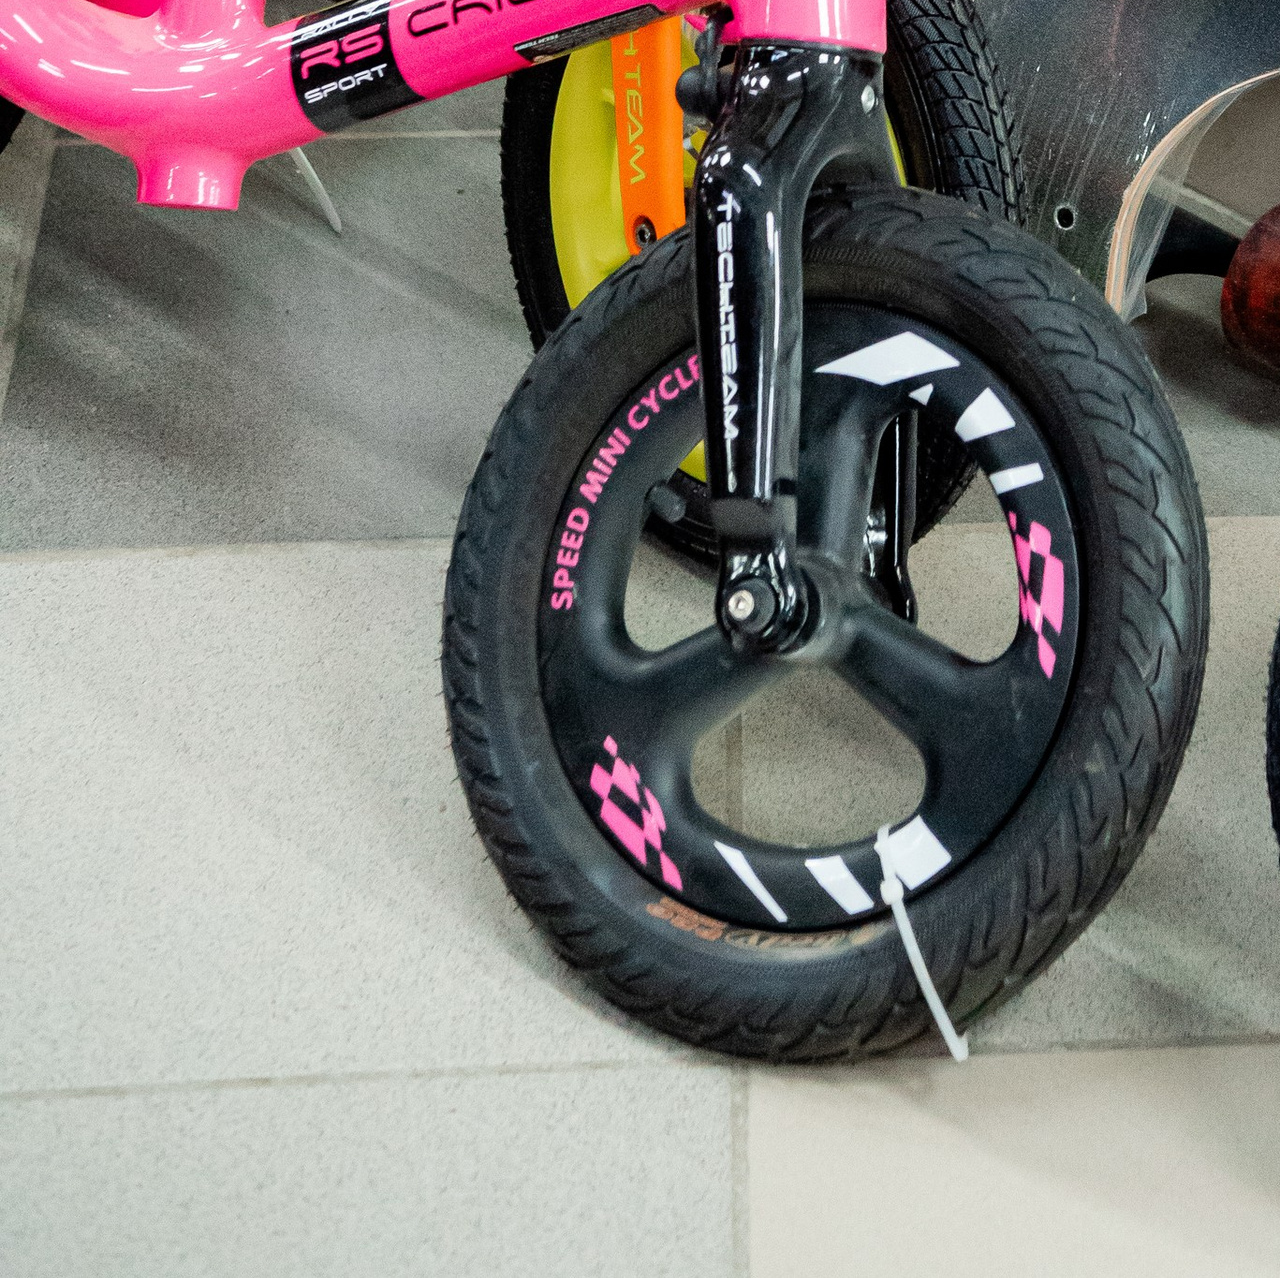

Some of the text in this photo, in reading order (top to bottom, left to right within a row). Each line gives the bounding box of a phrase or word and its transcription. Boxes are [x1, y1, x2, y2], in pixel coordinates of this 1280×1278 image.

[300, 23, 384, 80] RS
[304, 63, 388, 104] SPORT
[625, 63, 646, 185] TEAM
[716, 192, 740, 440] TECHTEAM
[550, 506, 590, 610] SPEED
[579, 427, 632, 504] MINI
